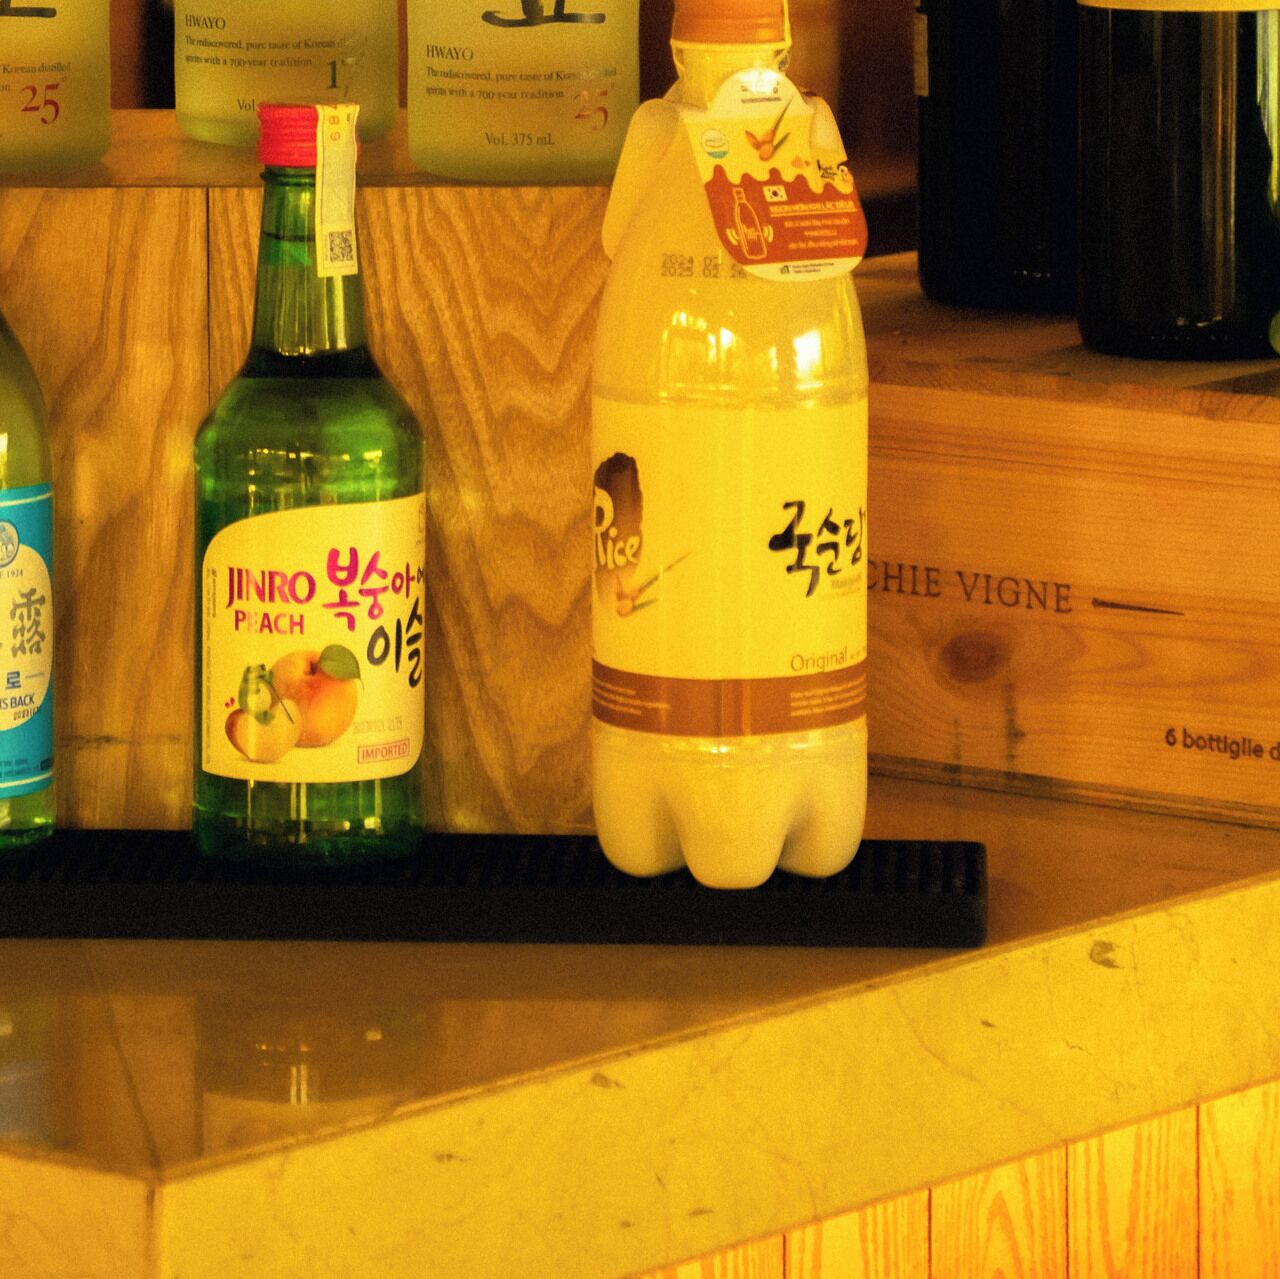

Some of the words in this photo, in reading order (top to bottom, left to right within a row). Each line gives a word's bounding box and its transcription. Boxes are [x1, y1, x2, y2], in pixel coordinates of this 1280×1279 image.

[184, 14, 227, 31] HWAYO
[426, 44, 474, 62] HWAYO
[511, 132, 534, 146] 375
[768, 500, 867, 599] 국순당
[225, 567, 317, 609] JINRO
[955, 569, 1074, 614] VIGNE
[235, 609, 306, 636] PEACH
[366, 595, 423, 690] 이슬
[790, 646, 848, 673] Original
[10, 692, 36, 710] BACK
[361, 742, 408, 761] IMPORTED
[1164, 727, 1178, 747] 6
[1182, 728, 1265, 761] bottiglie
